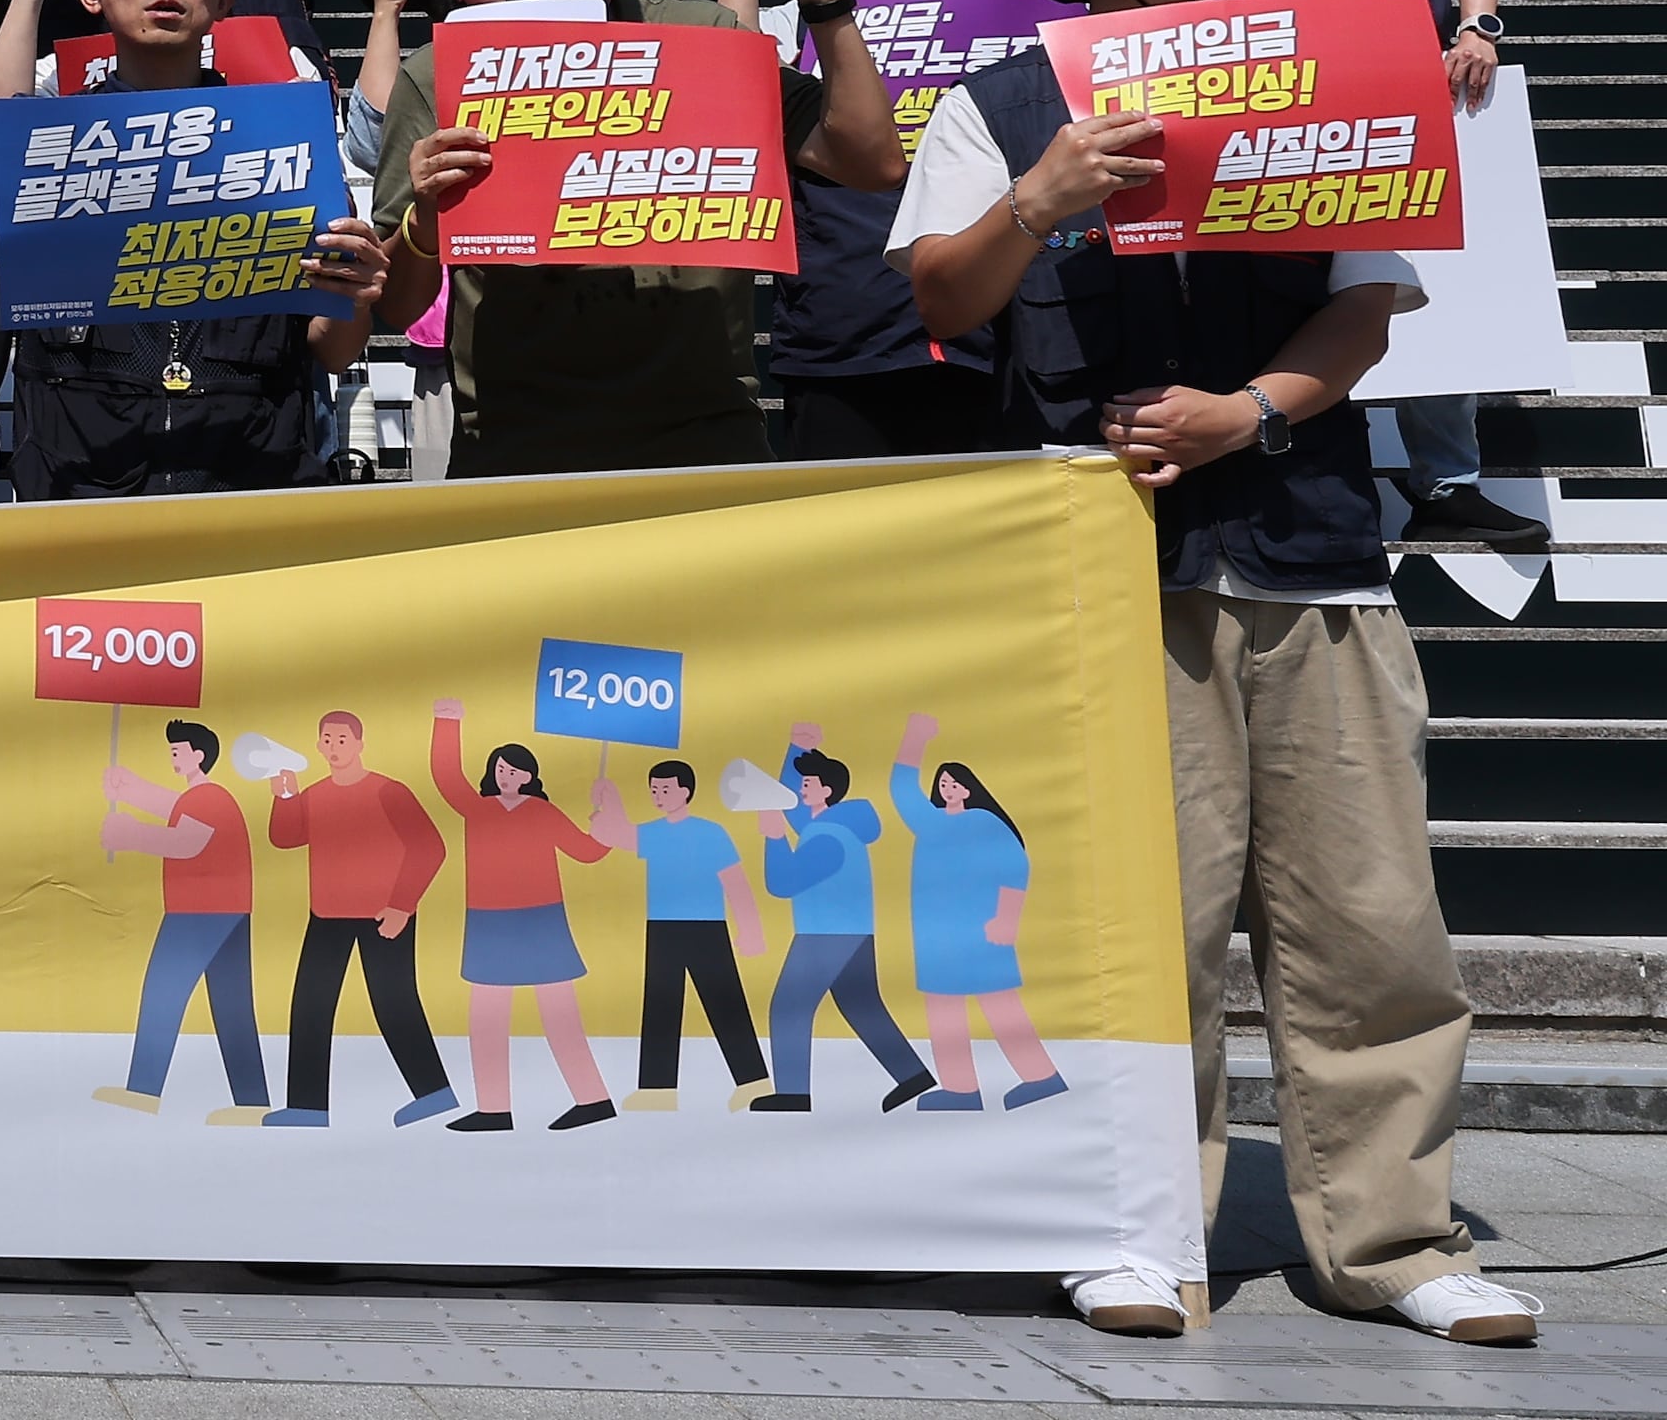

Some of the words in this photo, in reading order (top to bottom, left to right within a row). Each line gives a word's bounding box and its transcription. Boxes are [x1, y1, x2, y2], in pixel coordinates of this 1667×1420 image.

[460, 40, 661, 95] 최저임금
[1089, 9, 1296, 85] 최저임금
[559, 146, 758, 199] 실질임금
[1212, 114, 1417, 182] 실질임금
[11, 162, 160, 223] 플랫폼
[166, 141, 312, 205] 노동자
[1195, 167, 1447, 234] 보장하라!!
[116, 204, 316, 267] 최저임금
[547, 194, 782, 249] 보장하라!!
[44, 624, 196, 671] 12,000
[549, 667, 674, 711] 12,000
